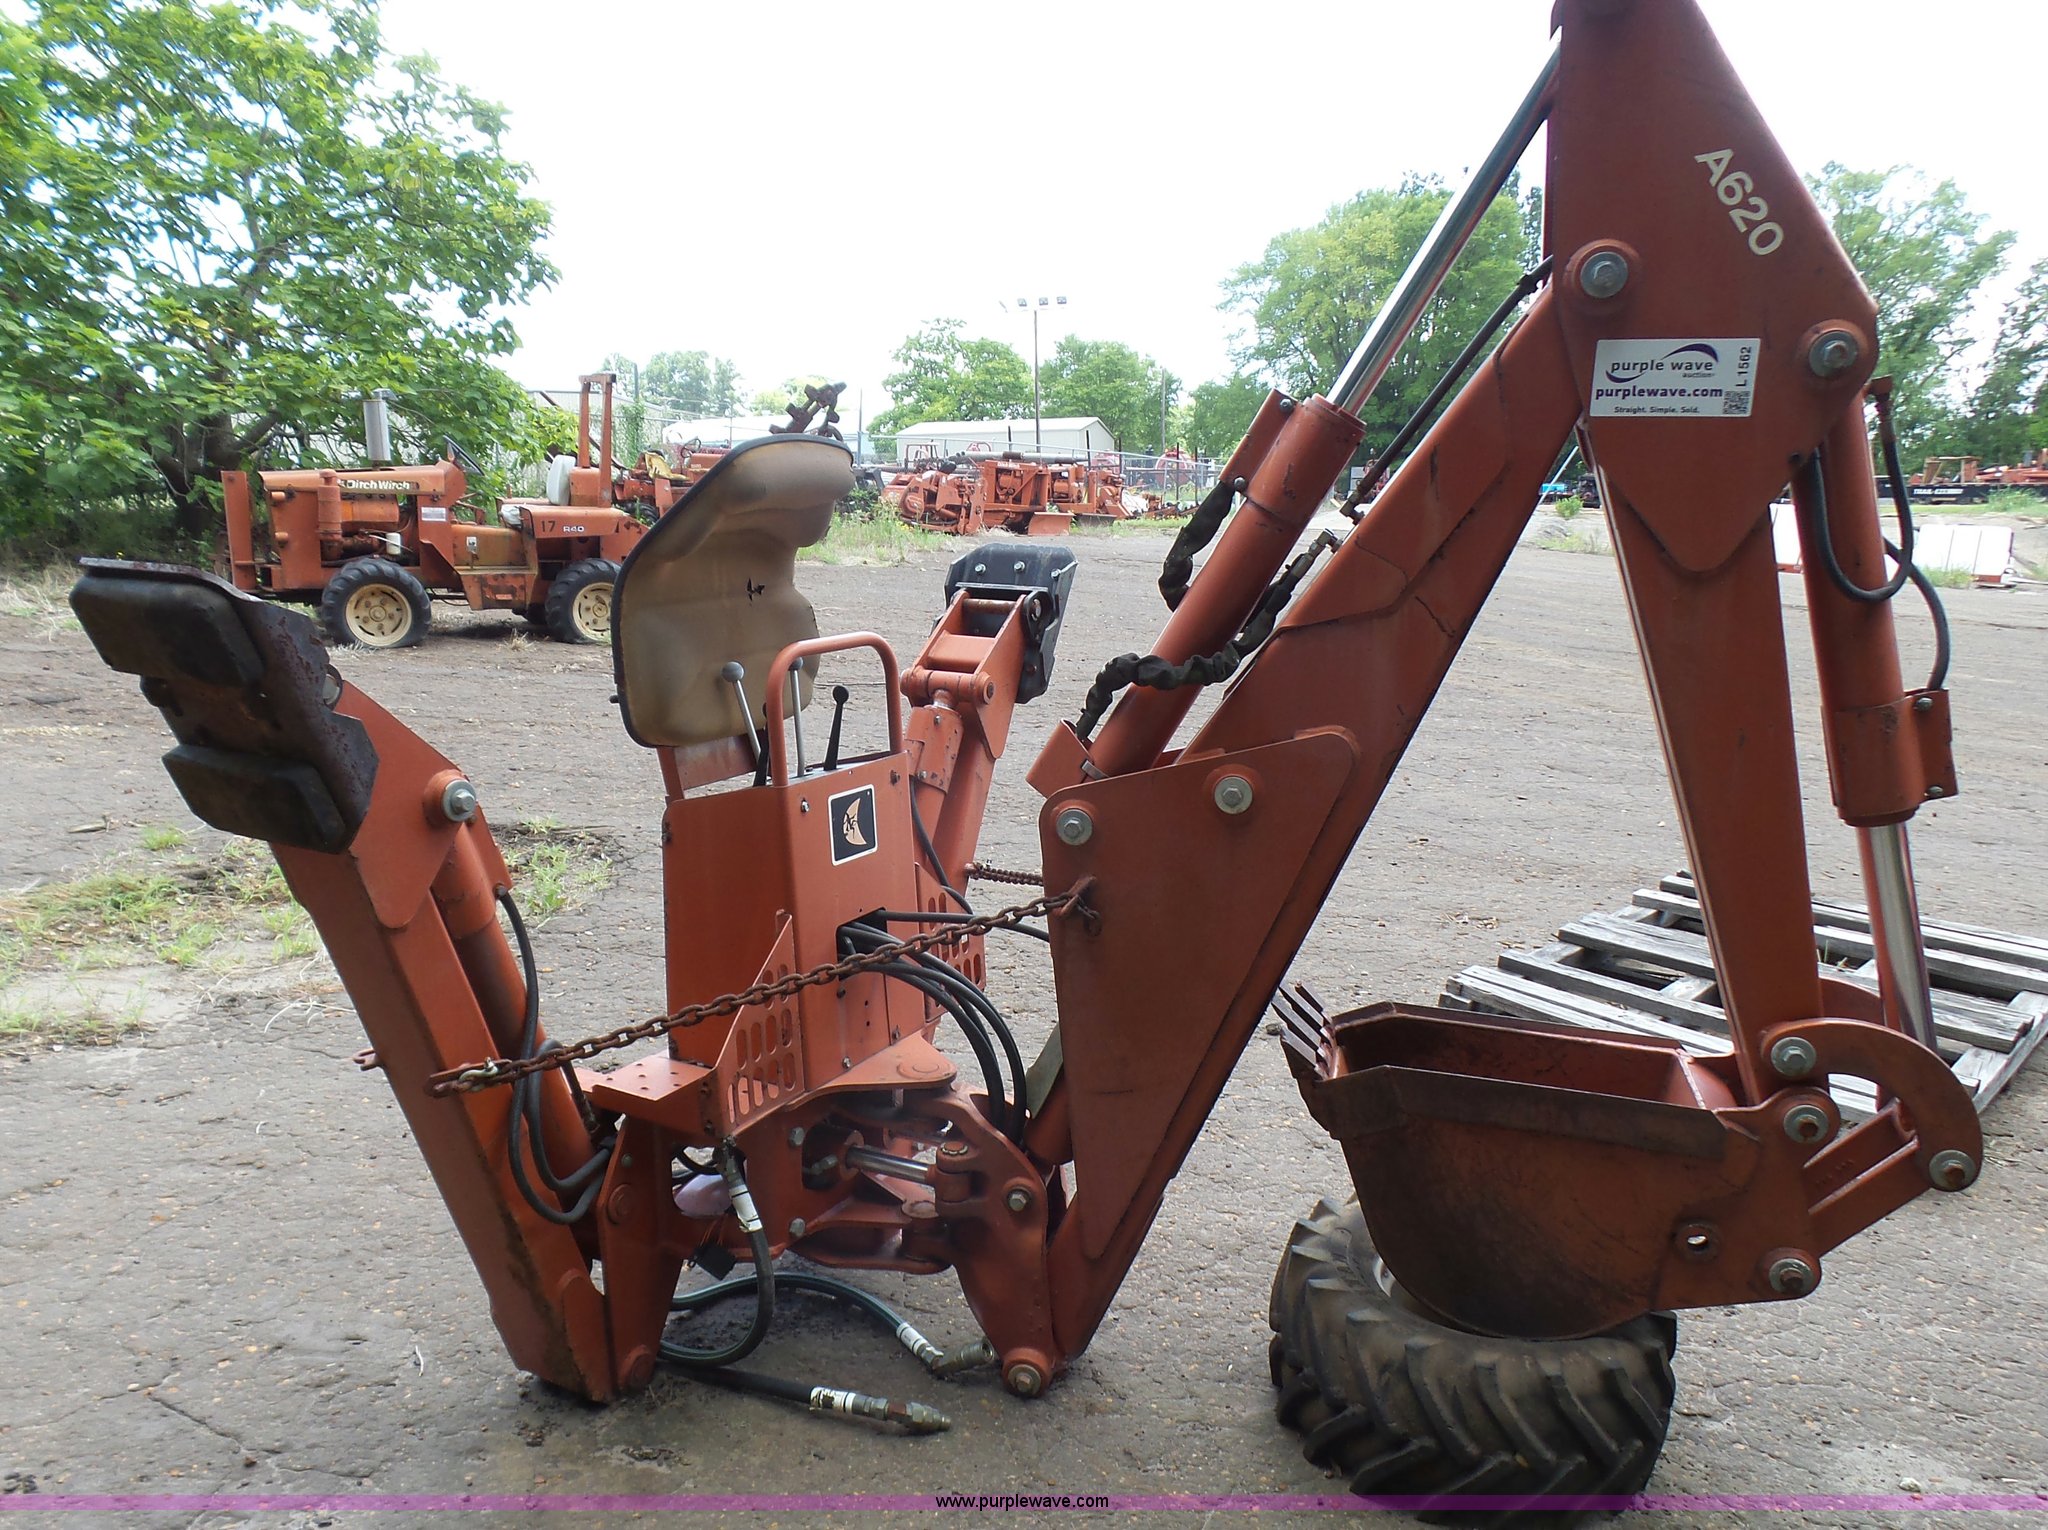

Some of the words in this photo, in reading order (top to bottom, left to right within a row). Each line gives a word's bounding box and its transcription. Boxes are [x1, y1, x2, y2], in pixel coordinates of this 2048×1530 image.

[1694, 148, 1784, 255] A620
[1611, 359, 1664, 373] purple
[1671, 361, 1713, 371] wave
[1737, 346, 1752, 376] 1562
[1595, 385, 1723, 400] purplewave.com
[1614, 406, 1647, 414] Straight.
[1650, 406, 1678, 414] Simple.
[541, 520, 556, 532] 17
